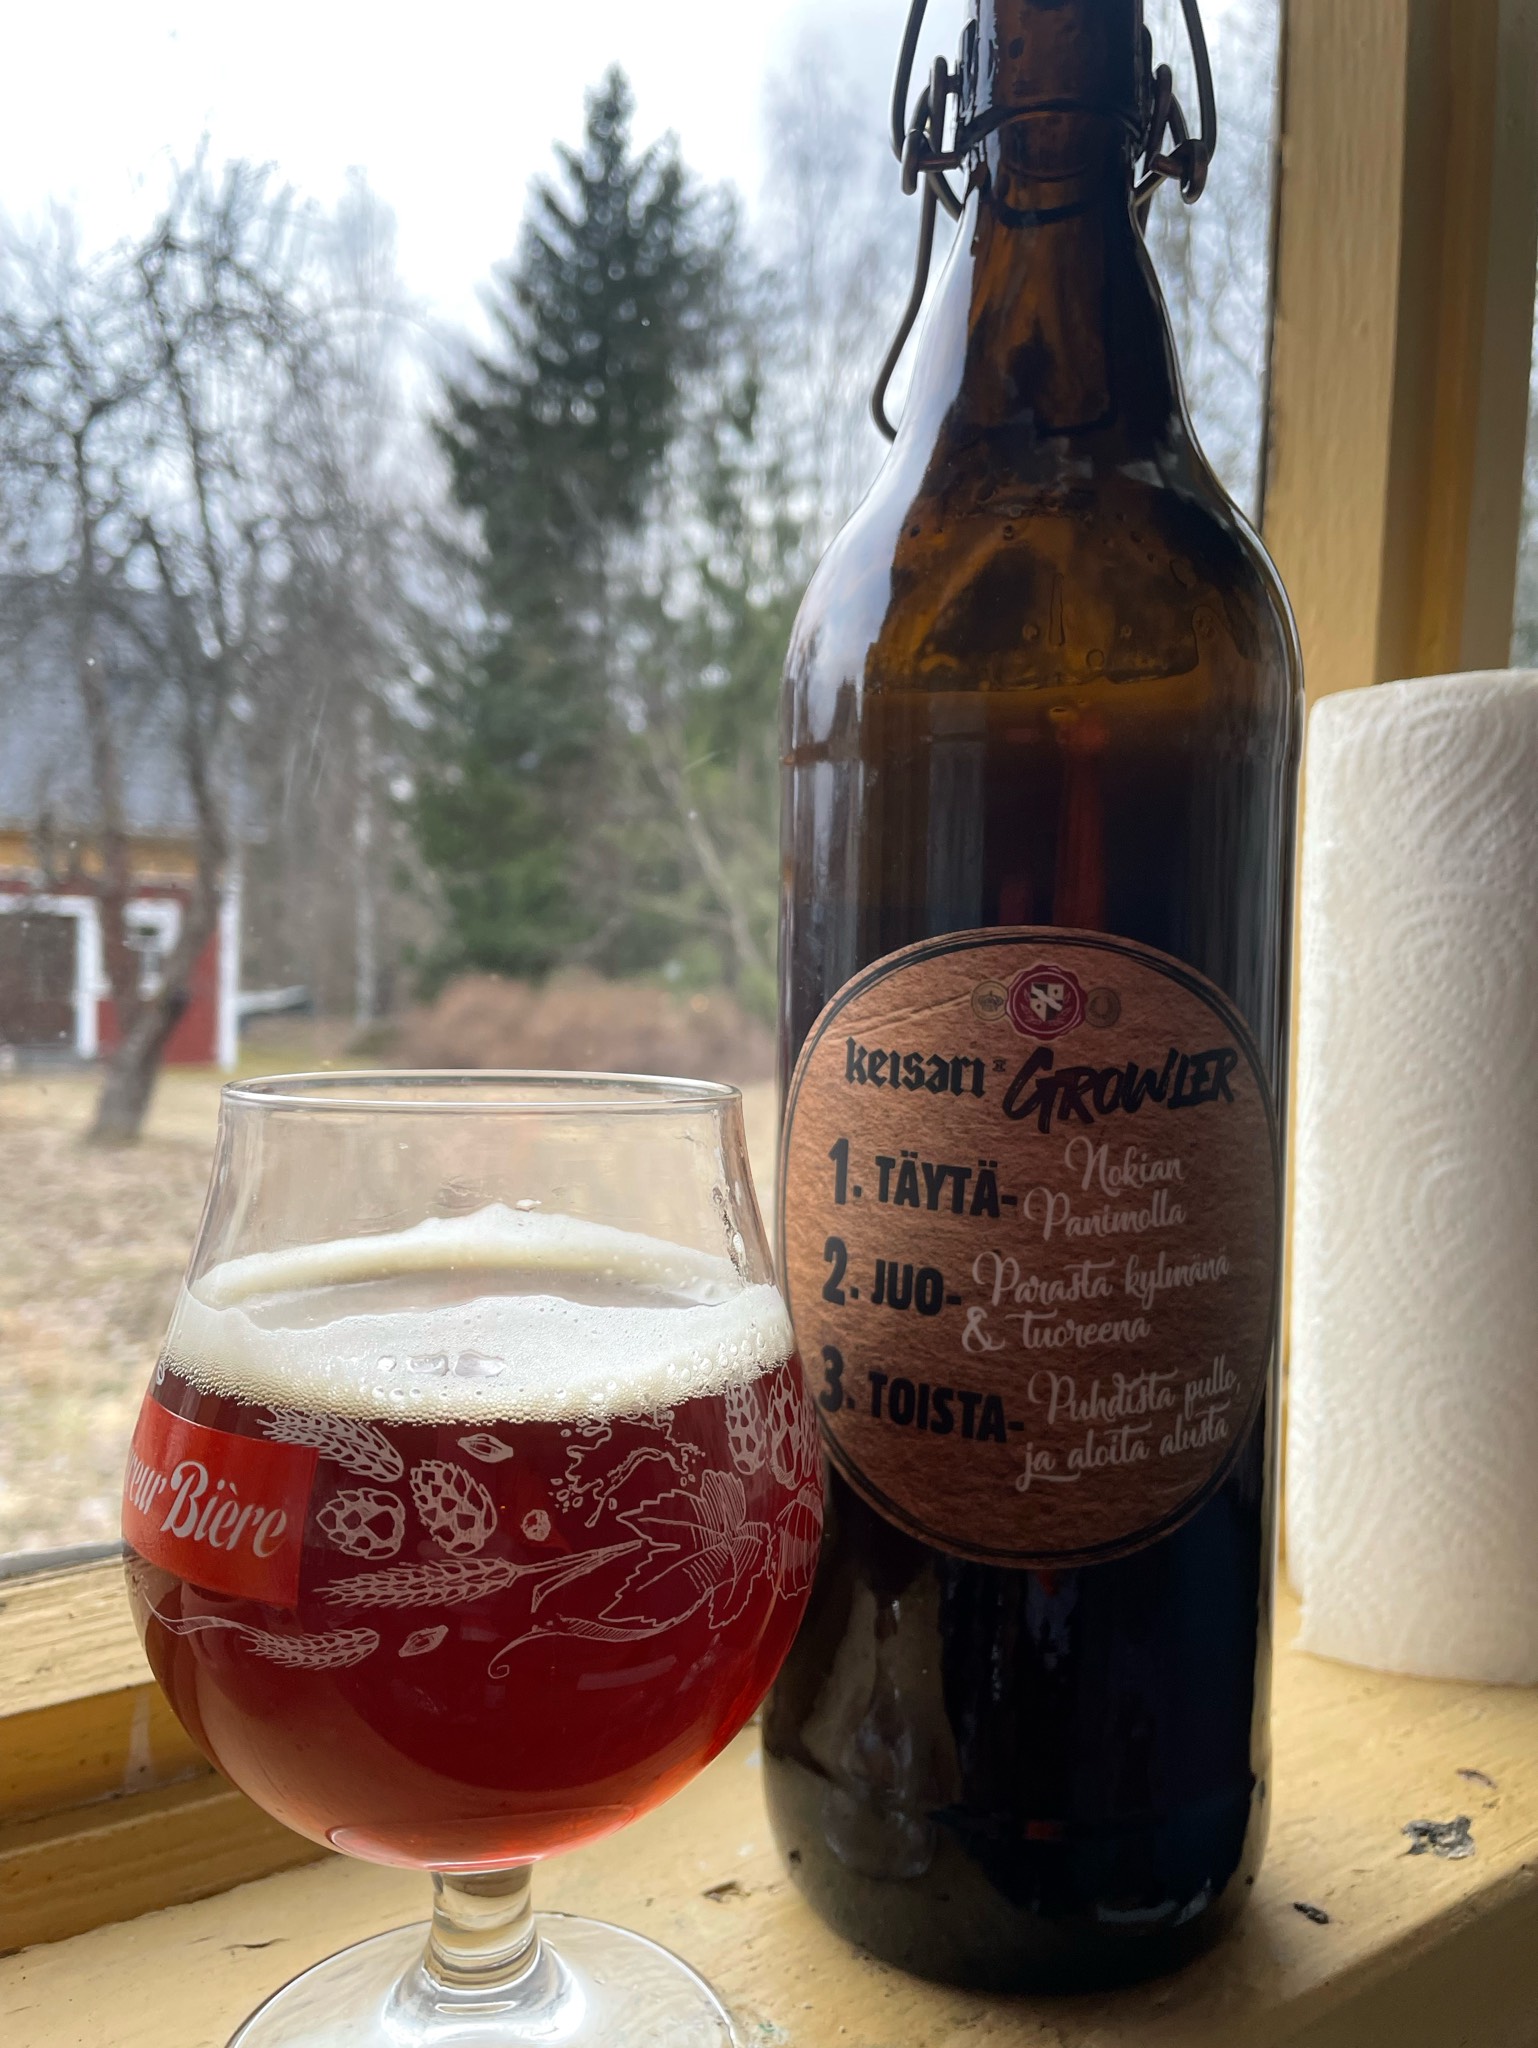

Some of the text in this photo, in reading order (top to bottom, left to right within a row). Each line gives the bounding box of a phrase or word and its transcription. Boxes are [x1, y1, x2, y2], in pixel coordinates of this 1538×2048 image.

[1002, 1046, 1238, 1134] GROWLER
[828, 1137, 862, 1206] 1.
[1064, 1136, 1185, 1197] Nokian
[1022, 1186, 1187, 1241] Panimolla
[821, 1236, 859, 1306] 2.
[972, 1246, 1230, 1310] Parasta kylmänä
[960, 1307, 1151, 1353] & tuoreena
[817, 1344, 1024, 1443] 3. TOISTA-
[1026, 1366, 1179, 1425] Puhdista
[1015, 1398, 1232, 1493] ja aloita alusta
[160, 1460, 288, 1558] Bière
